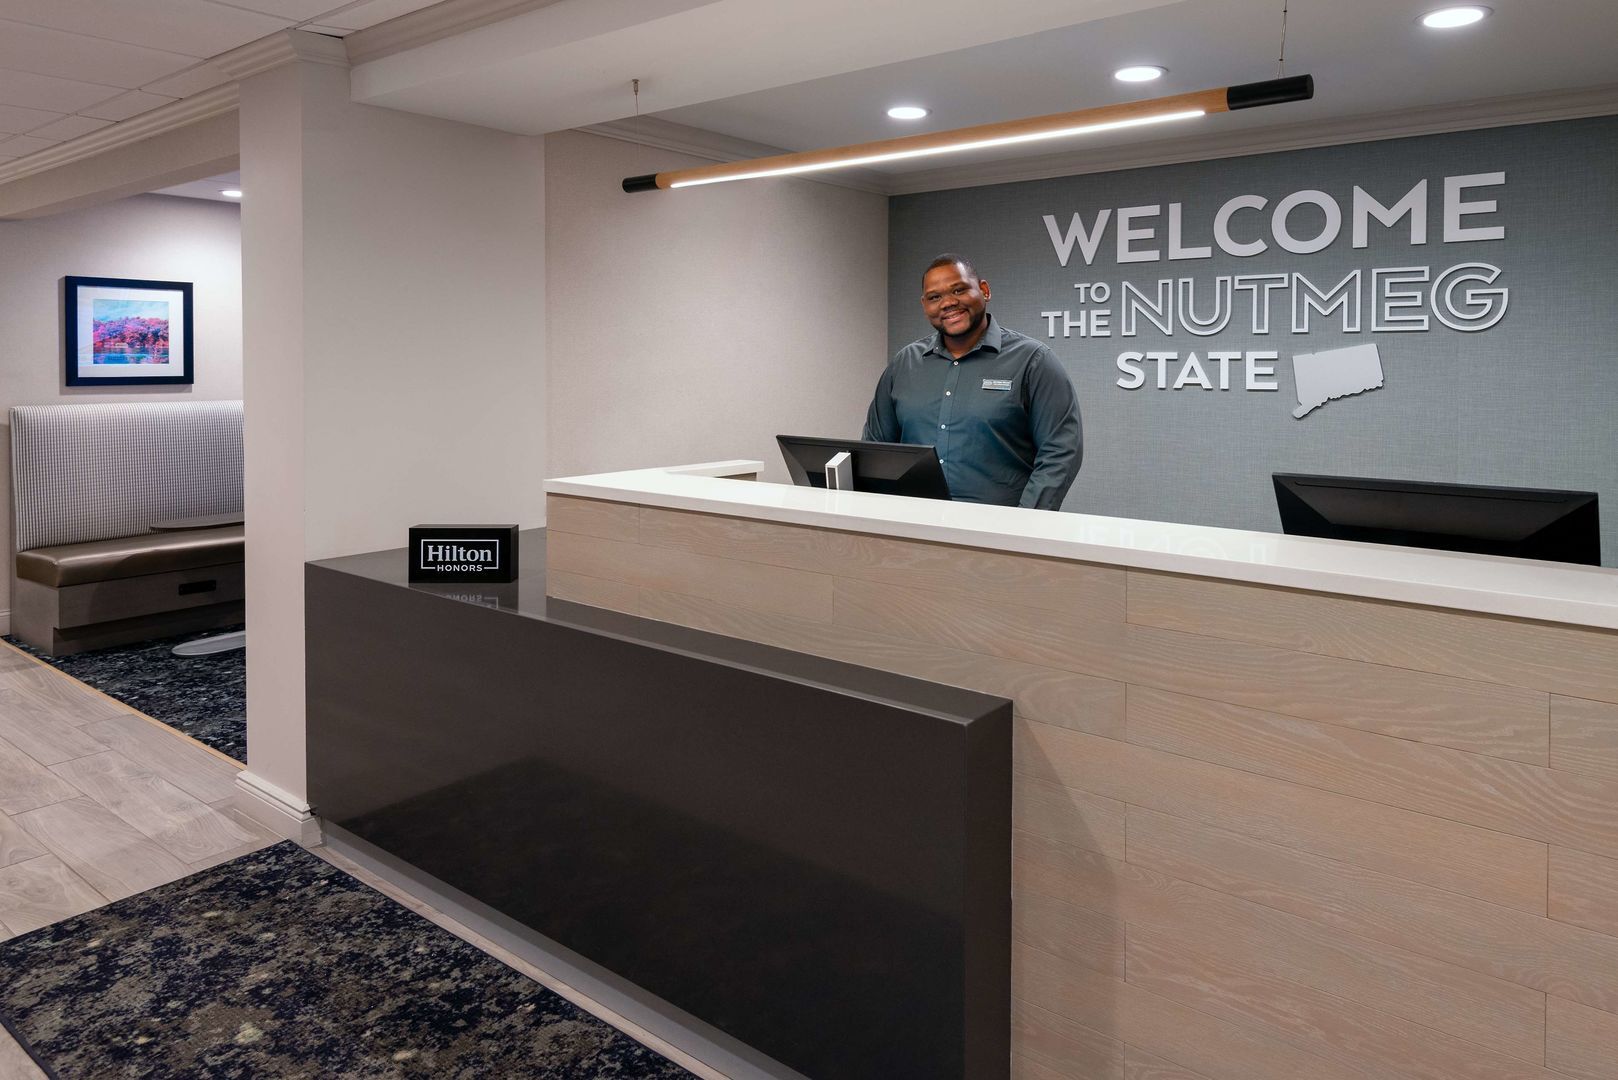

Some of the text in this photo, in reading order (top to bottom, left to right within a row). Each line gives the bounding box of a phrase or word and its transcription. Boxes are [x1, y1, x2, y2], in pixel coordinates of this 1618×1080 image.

[1042, 171, 1506, 267] WELCOME
[1041, 262, 1509, 338] THE NUTMEG
[1074, 282, 1111, 304] TO
[1116, 351, 1279, 391] STATE
[427, 545, 493, 562] Hilton
[437, 564, 483, 572] HONORS
